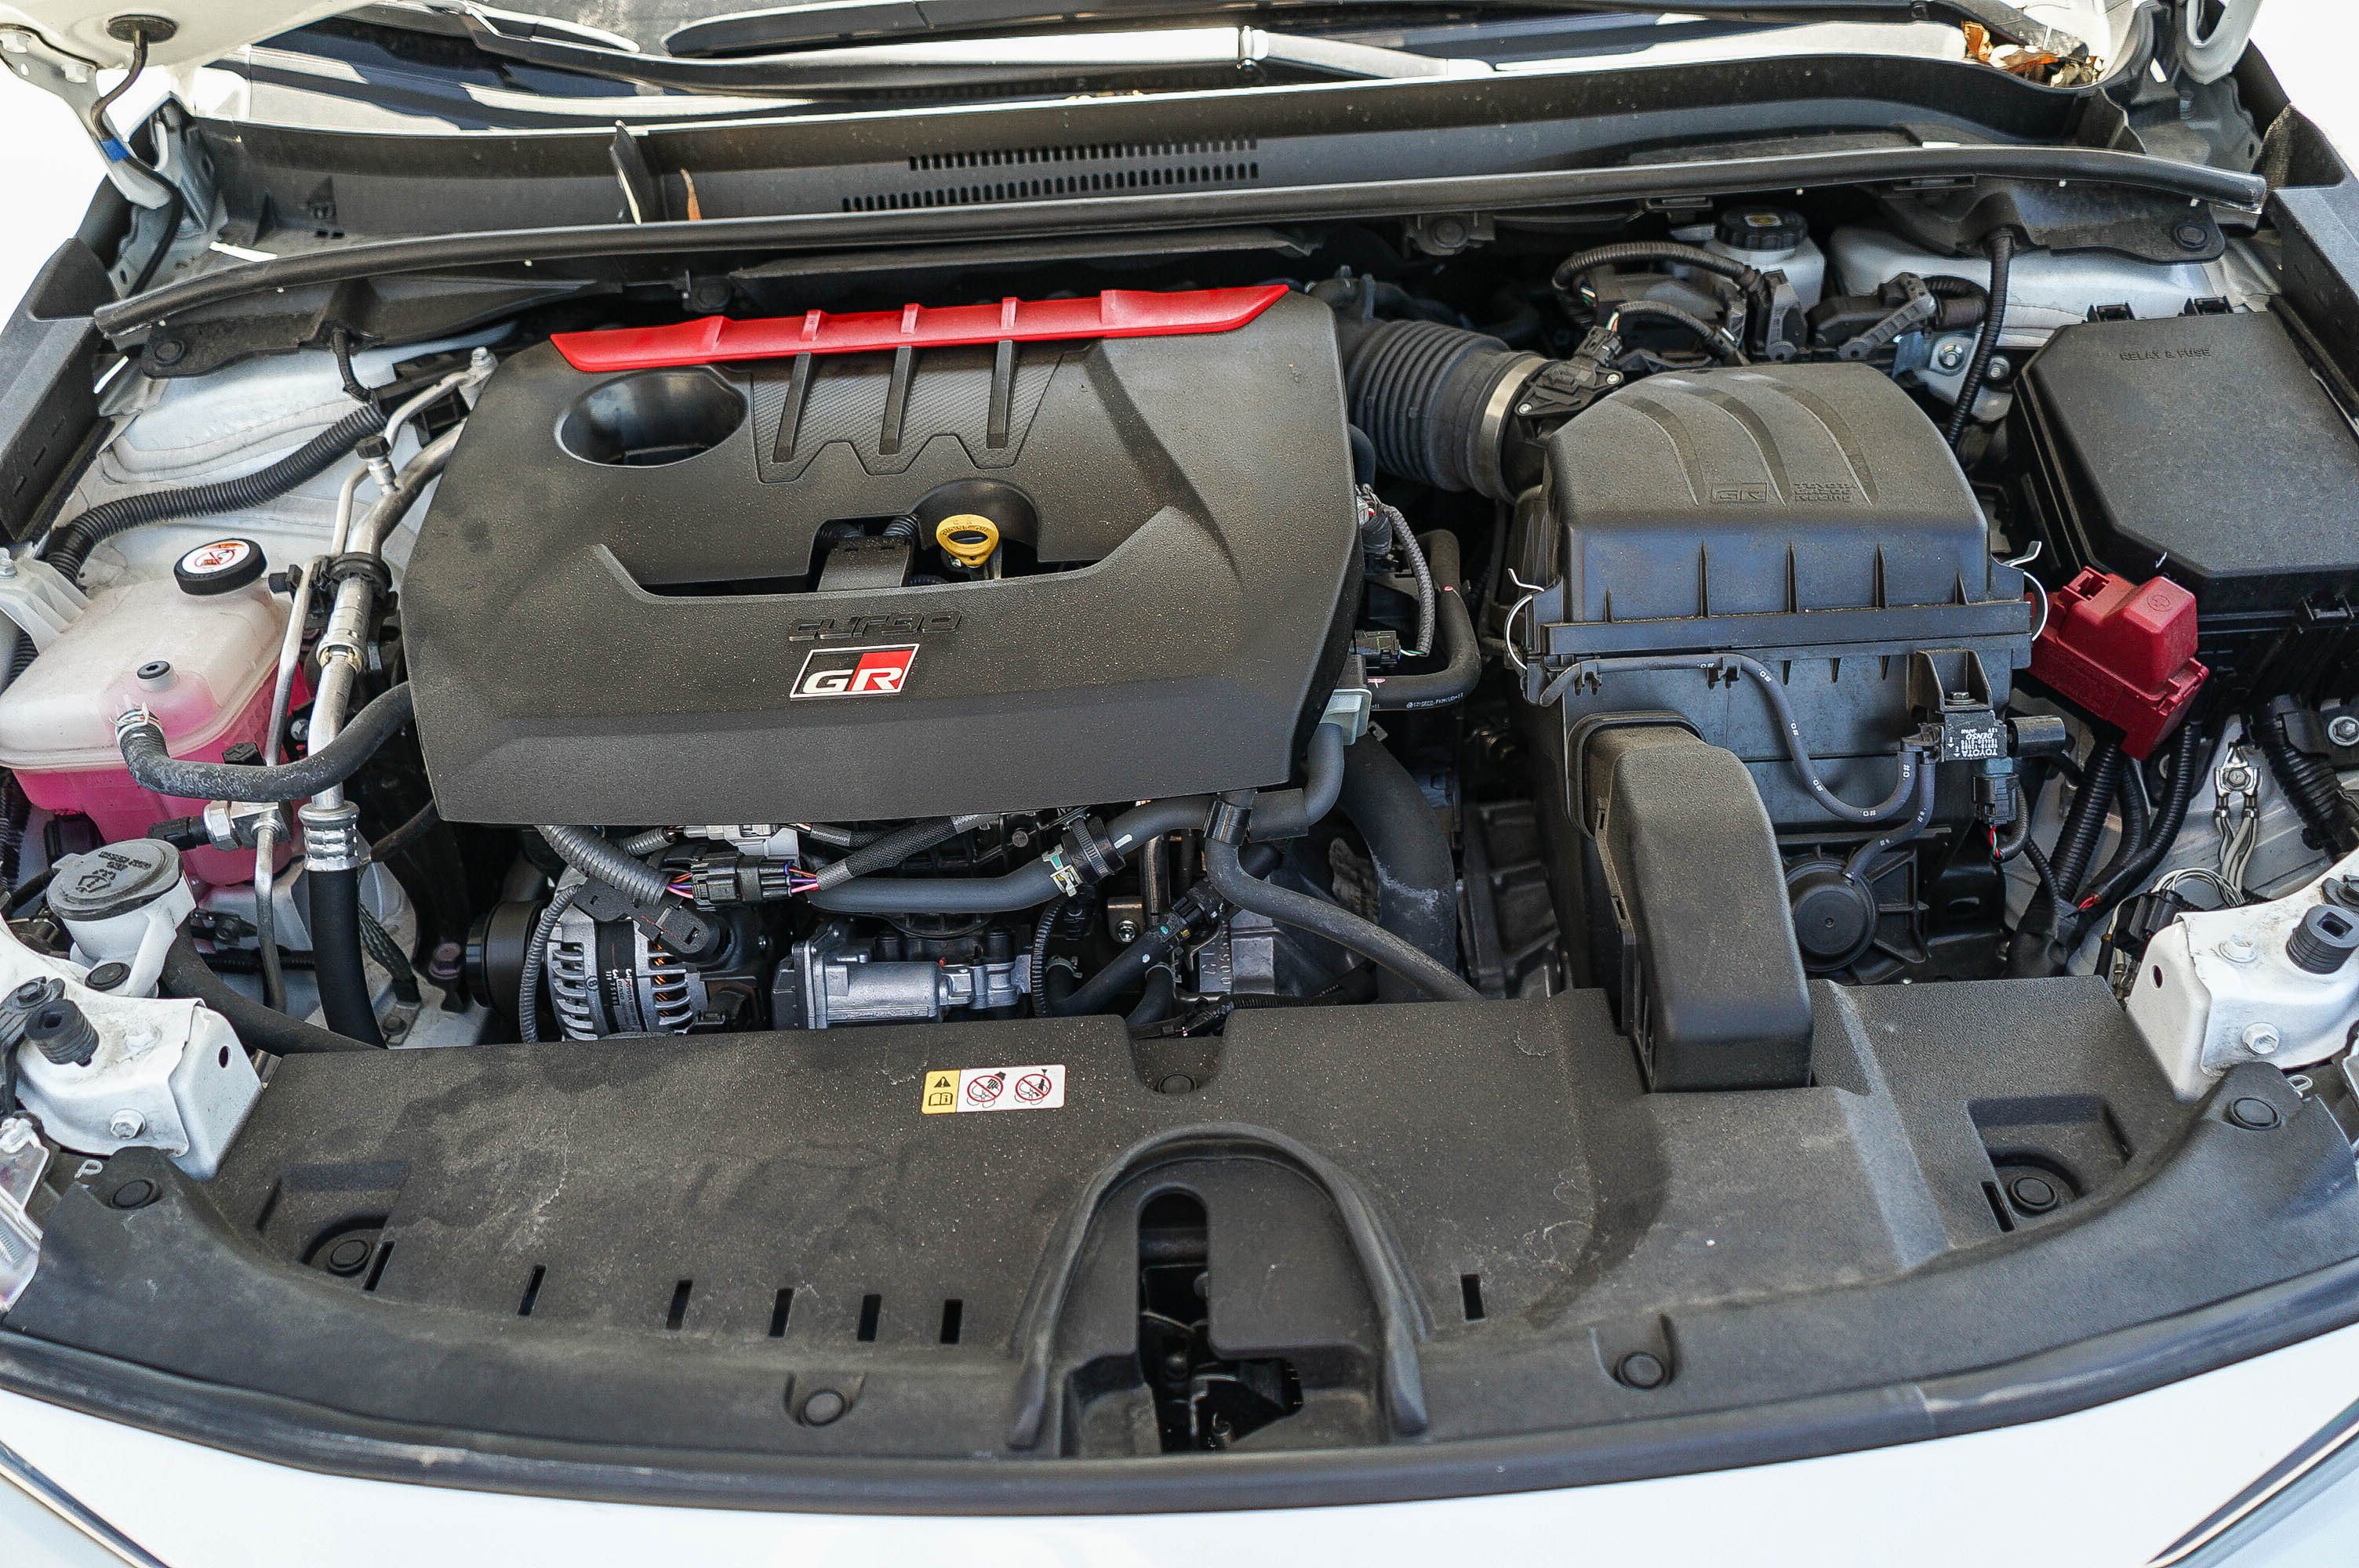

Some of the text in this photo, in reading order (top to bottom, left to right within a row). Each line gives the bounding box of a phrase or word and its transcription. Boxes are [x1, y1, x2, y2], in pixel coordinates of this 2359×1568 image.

[2119, 350, 2161, 361] RELAY
[2176, 347, 2212, 358] FUSE
[802, 666, 903, 695] GR
[1961, 748, 1998, 757] TOYOTA
